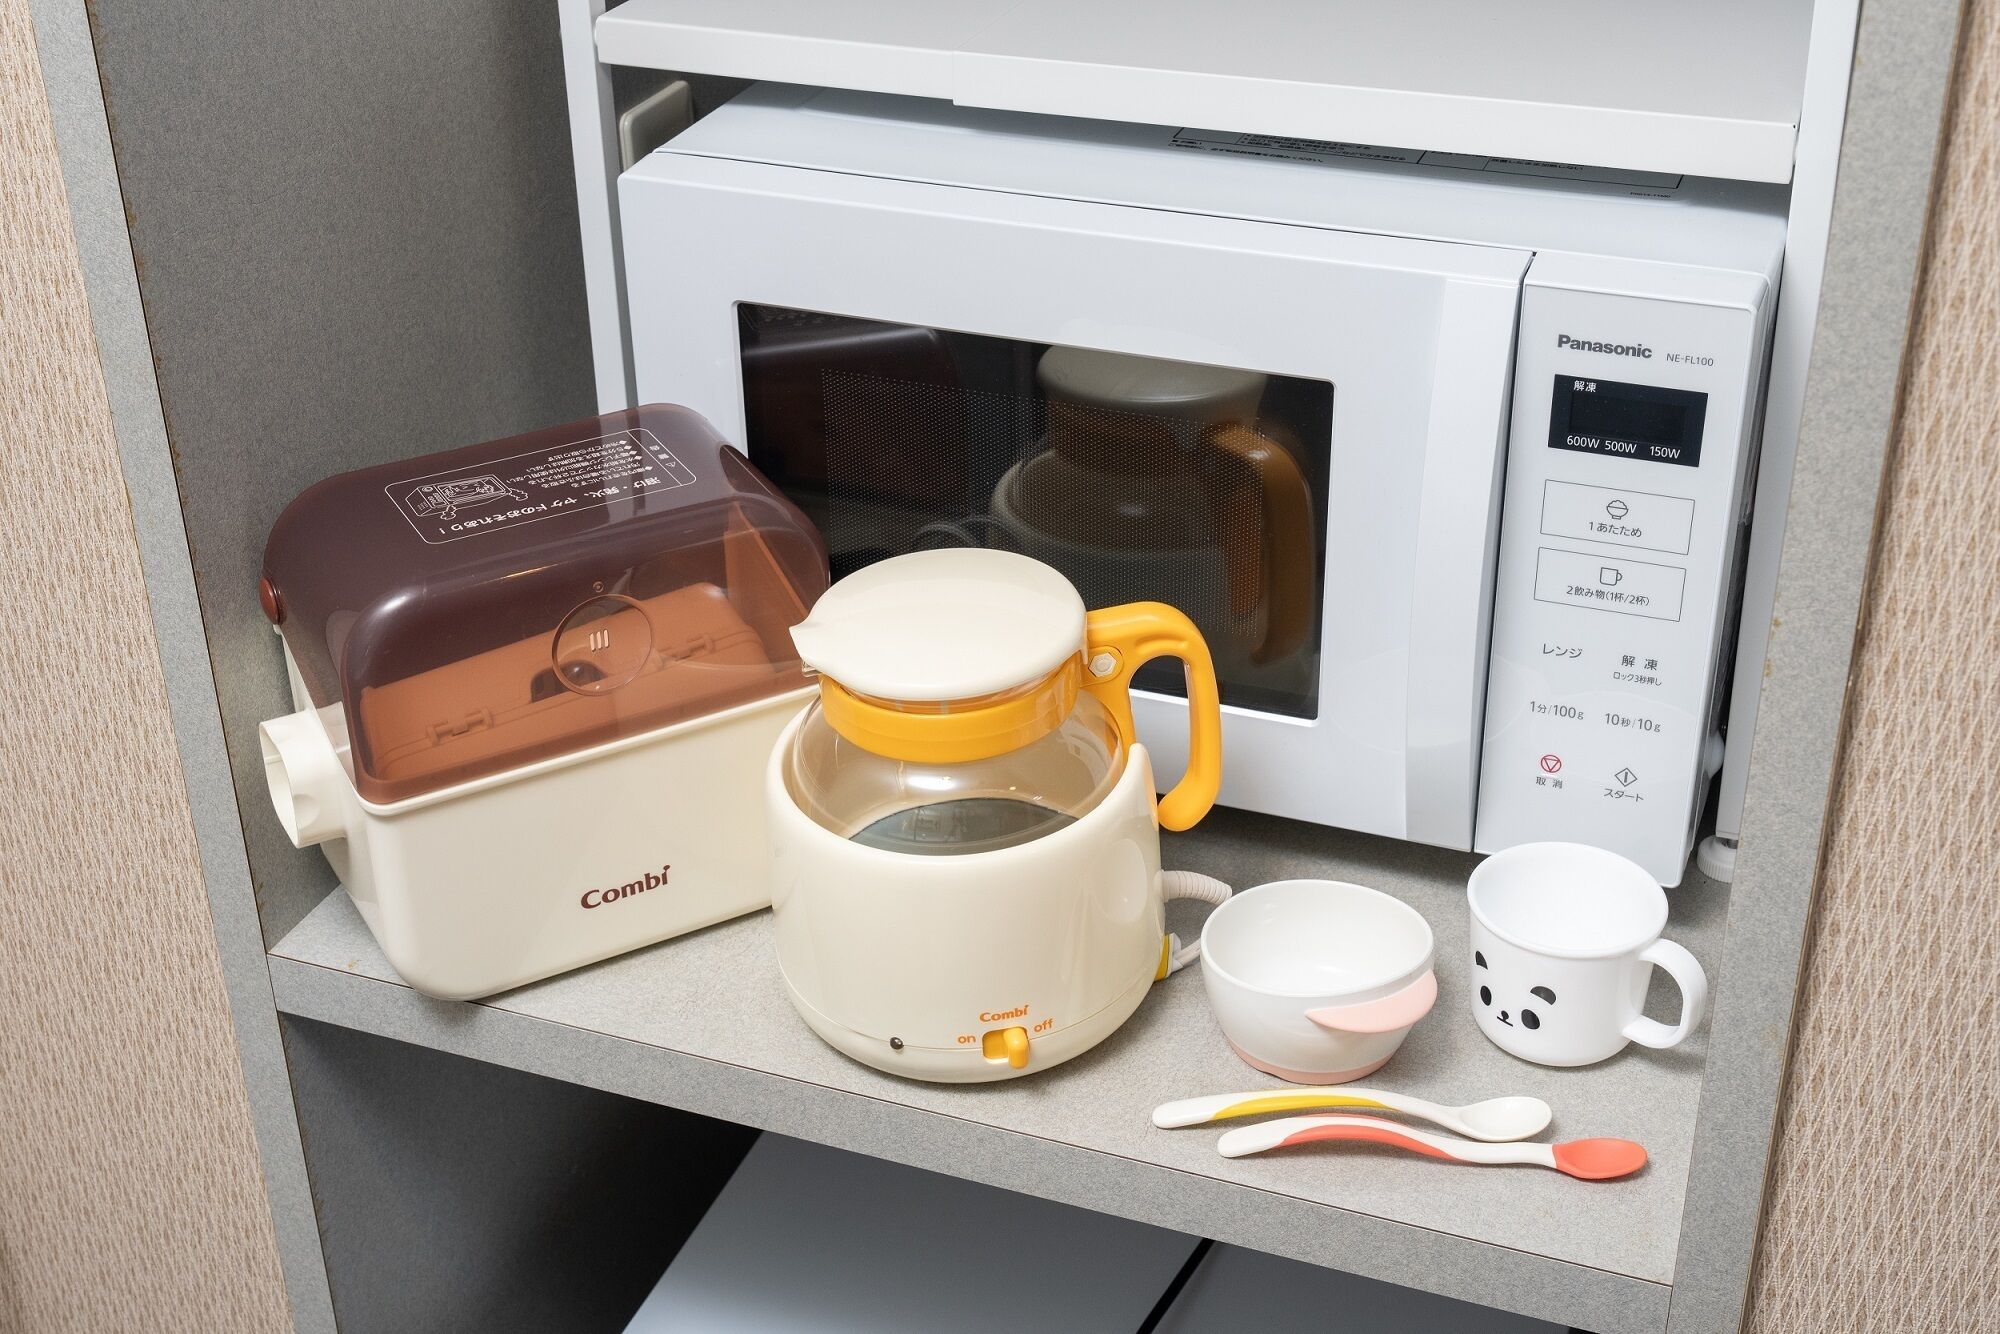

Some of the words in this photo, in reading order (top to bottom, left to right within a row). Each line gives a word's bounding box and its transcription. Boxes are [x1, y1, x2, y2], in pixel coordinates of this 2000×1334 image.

[1557, 334, 1653, 359] Panasonic
[1666, 353, 1714, 367] NE-FL100
[1573, 380, 1597, 393] 解凍
[1567, 435, 1600, 449] 600W
[1605, 441, 1637, 453] 500W
[1650, 446, 1681, 459] 150W
[1542, 643, 1583, 659] レンジ
[1613, 672, 1662, 686] ロック3秒押し
[1530, 701, 1584, 720] 1分/100g
[1605, 713, 1661, 733] 10秒/10g
[1604, 788, 1644, 802] スタート
[581, 865, 671, 909] Combi
[979, 1005, 1029, 1022] Combi
[1034, 1018, 1054, 1033] off
[957, 1034, 976, 1044] on
